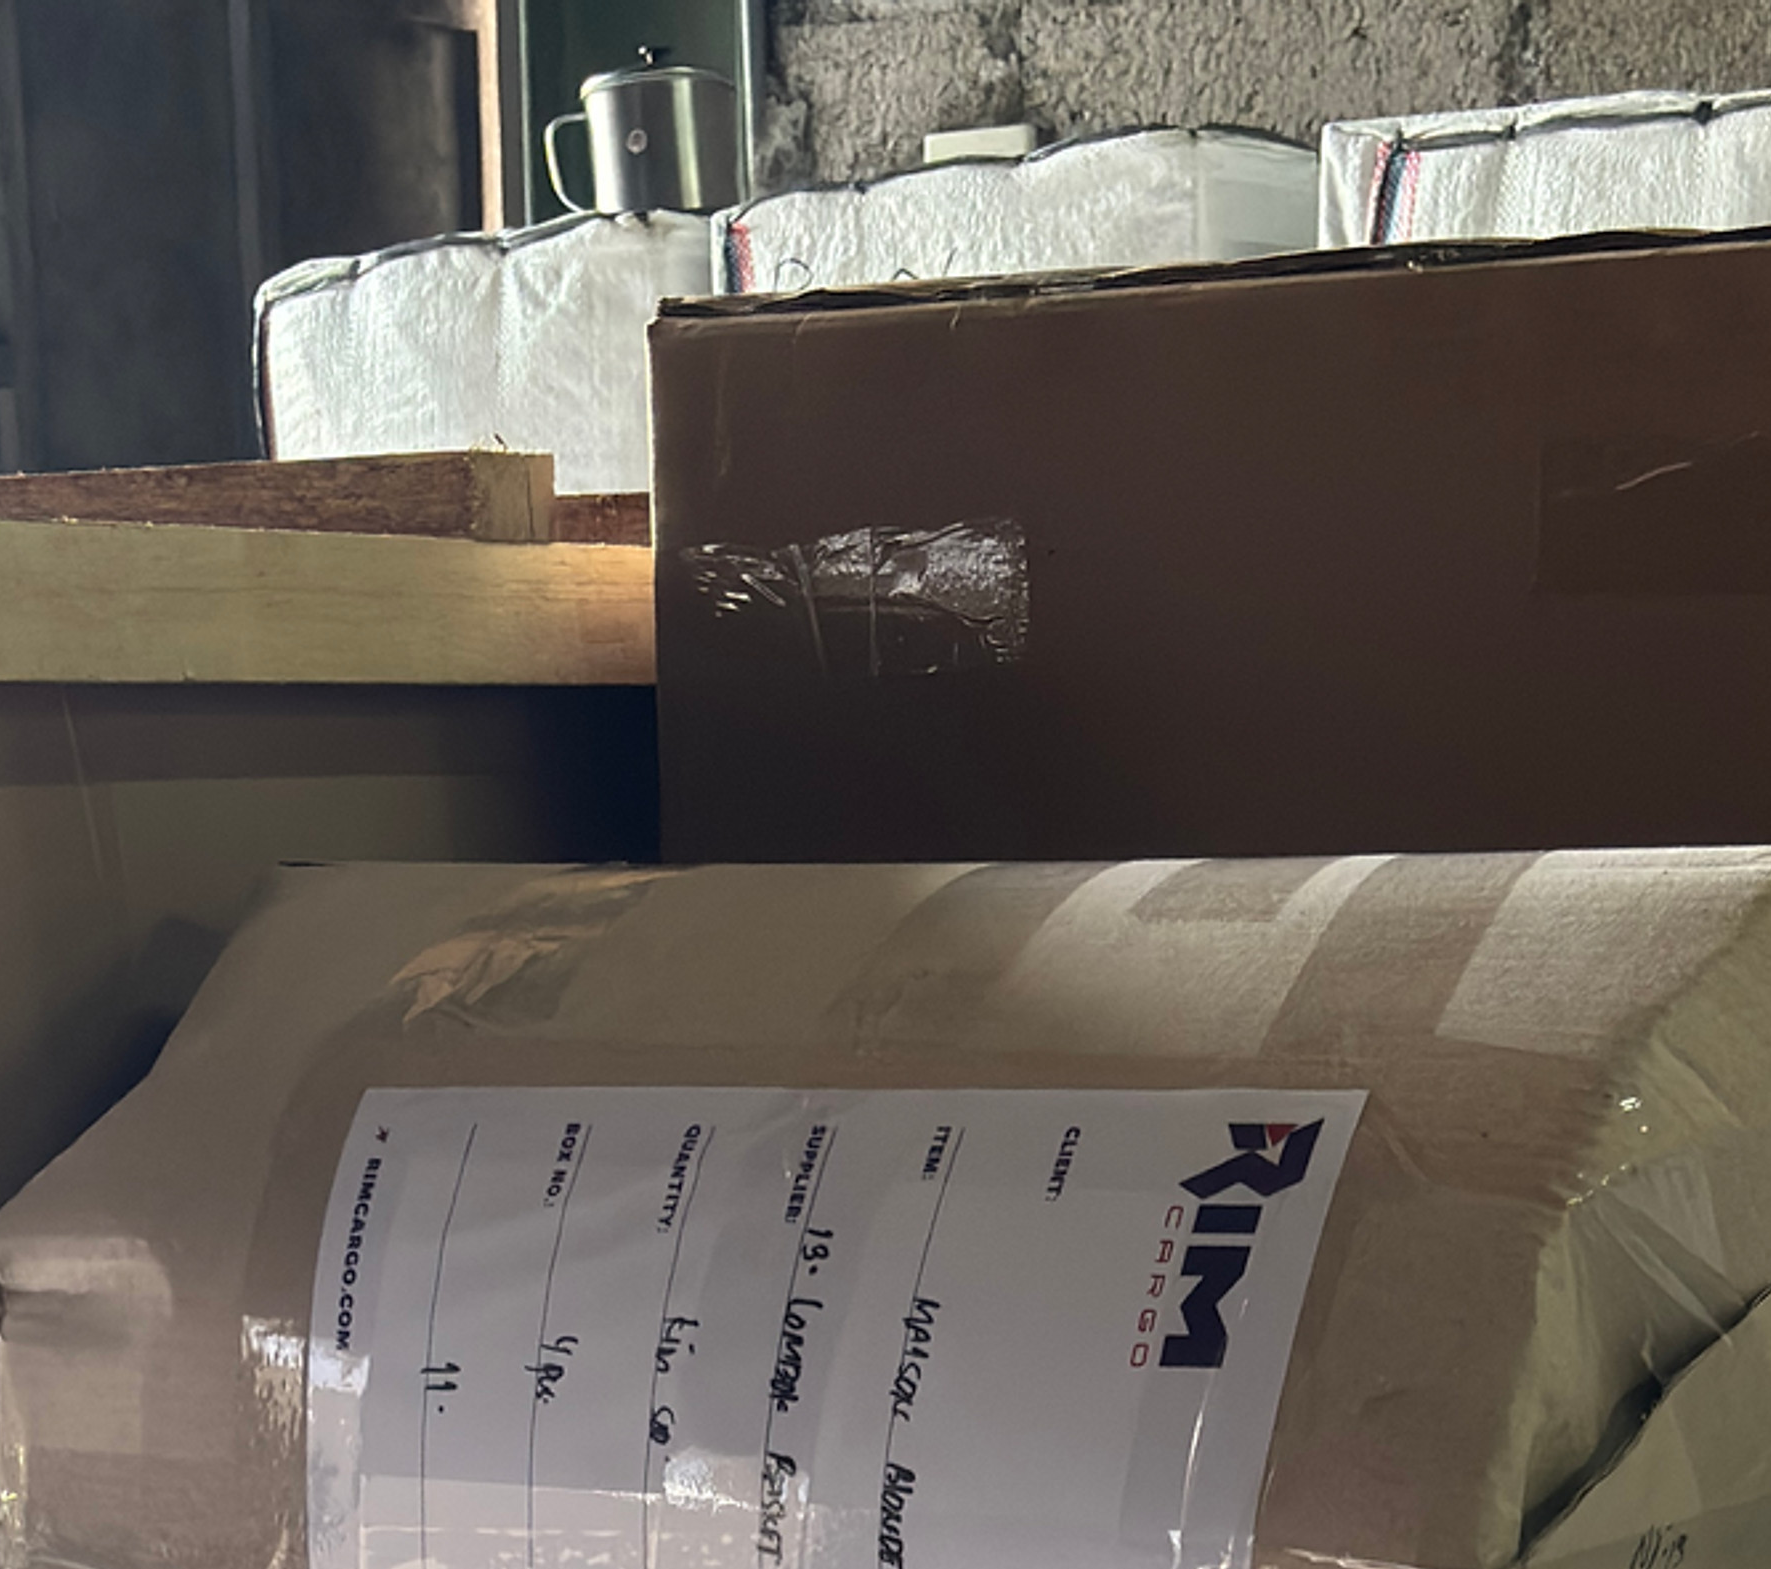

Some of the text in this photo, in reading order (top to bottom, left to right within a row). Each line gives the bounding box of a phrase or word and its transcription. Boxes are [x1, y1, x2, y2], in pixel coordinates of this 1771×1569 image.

[556, 1123, 581, 1163] BOX
[657, 1123, 702, 1234] QUANTITY:
[785, 1125, 827, 1224] SUPPLIER:
[921, 1125, 952, 1181] ITEM:
[1045, 1125, 1081, 1202] CLIENT:
[335, 1157, 382, 1351] RIMCARGO.COM
[1130, 1205, 1184, 1368] CARGO
[1159, 1117, 1324, 1369] RIM
